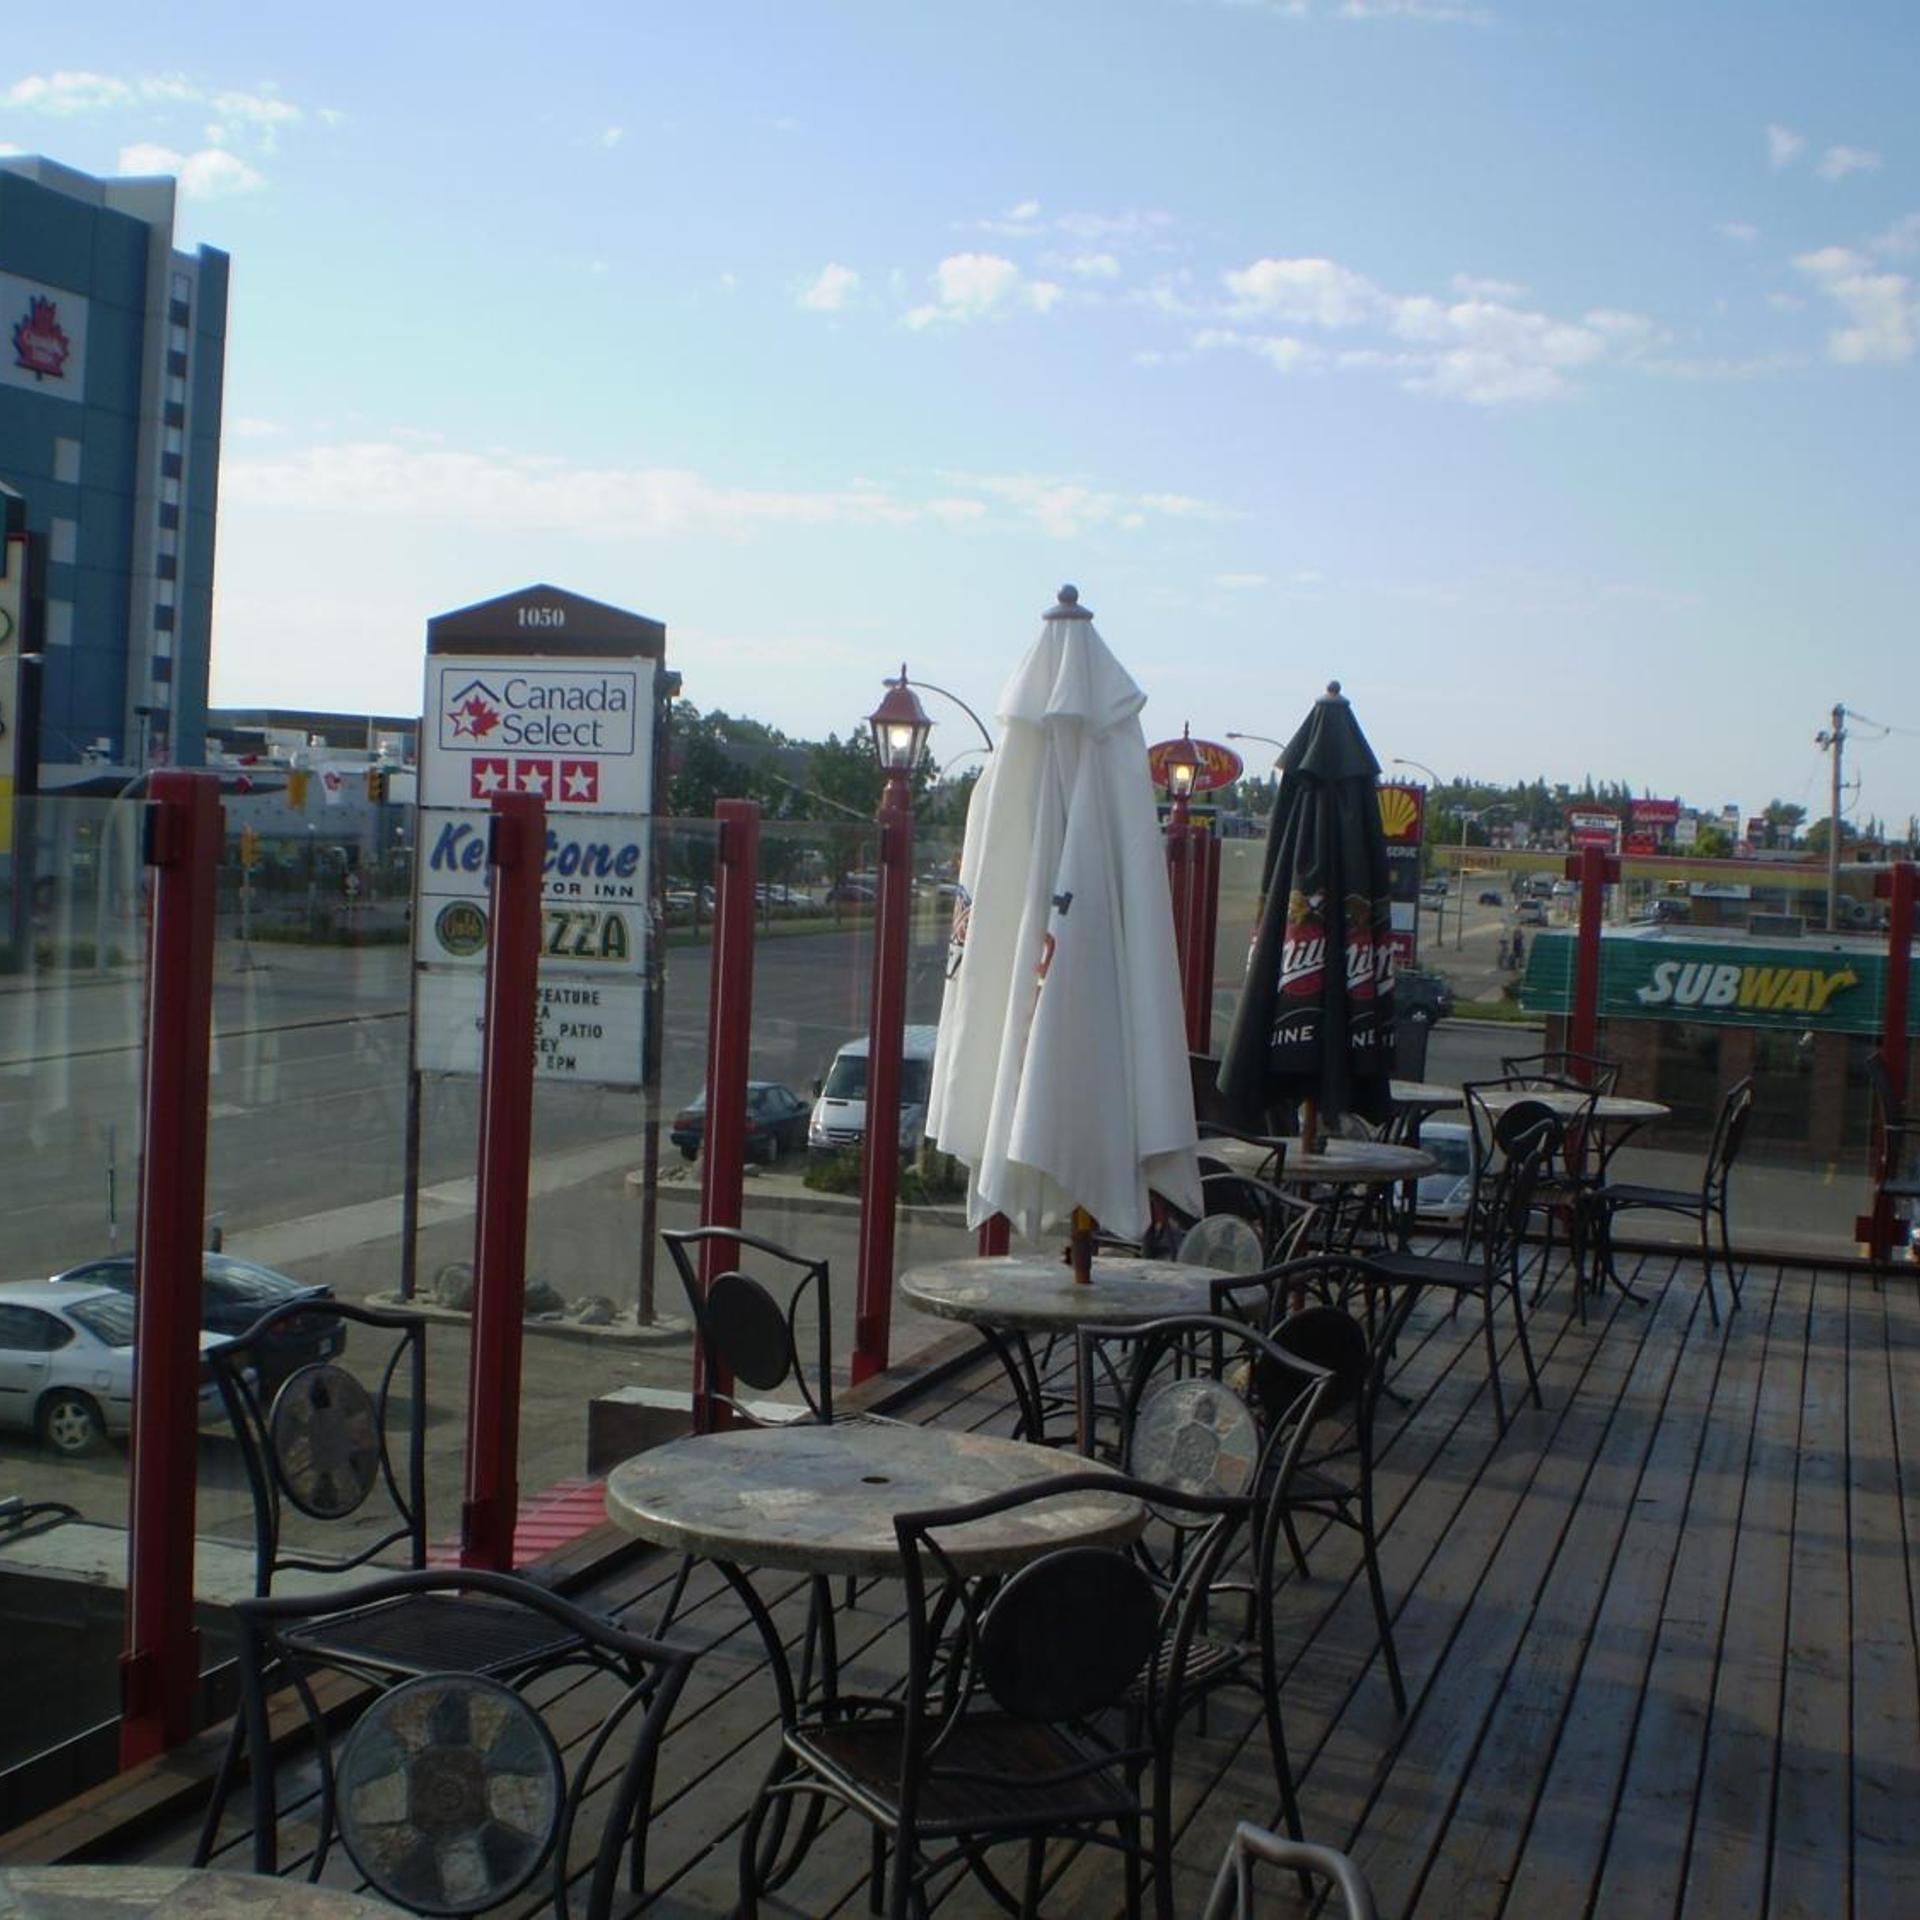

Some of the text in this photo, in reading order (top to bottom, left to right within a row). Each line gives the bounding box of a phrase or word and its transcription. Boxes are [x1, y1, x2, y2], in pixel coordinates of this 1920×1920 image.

[516, 607, 565, 627] 1050
[503, 679, 627, 711] Canada
[502, 714, 603, 747] Select
[429, 820, 641, 888] Ketone
[594, 884, 633, 897] INN
[1638, 960, 1858, 1014] SUBWAY
[560, 1023, 603, 1039] PATIO
